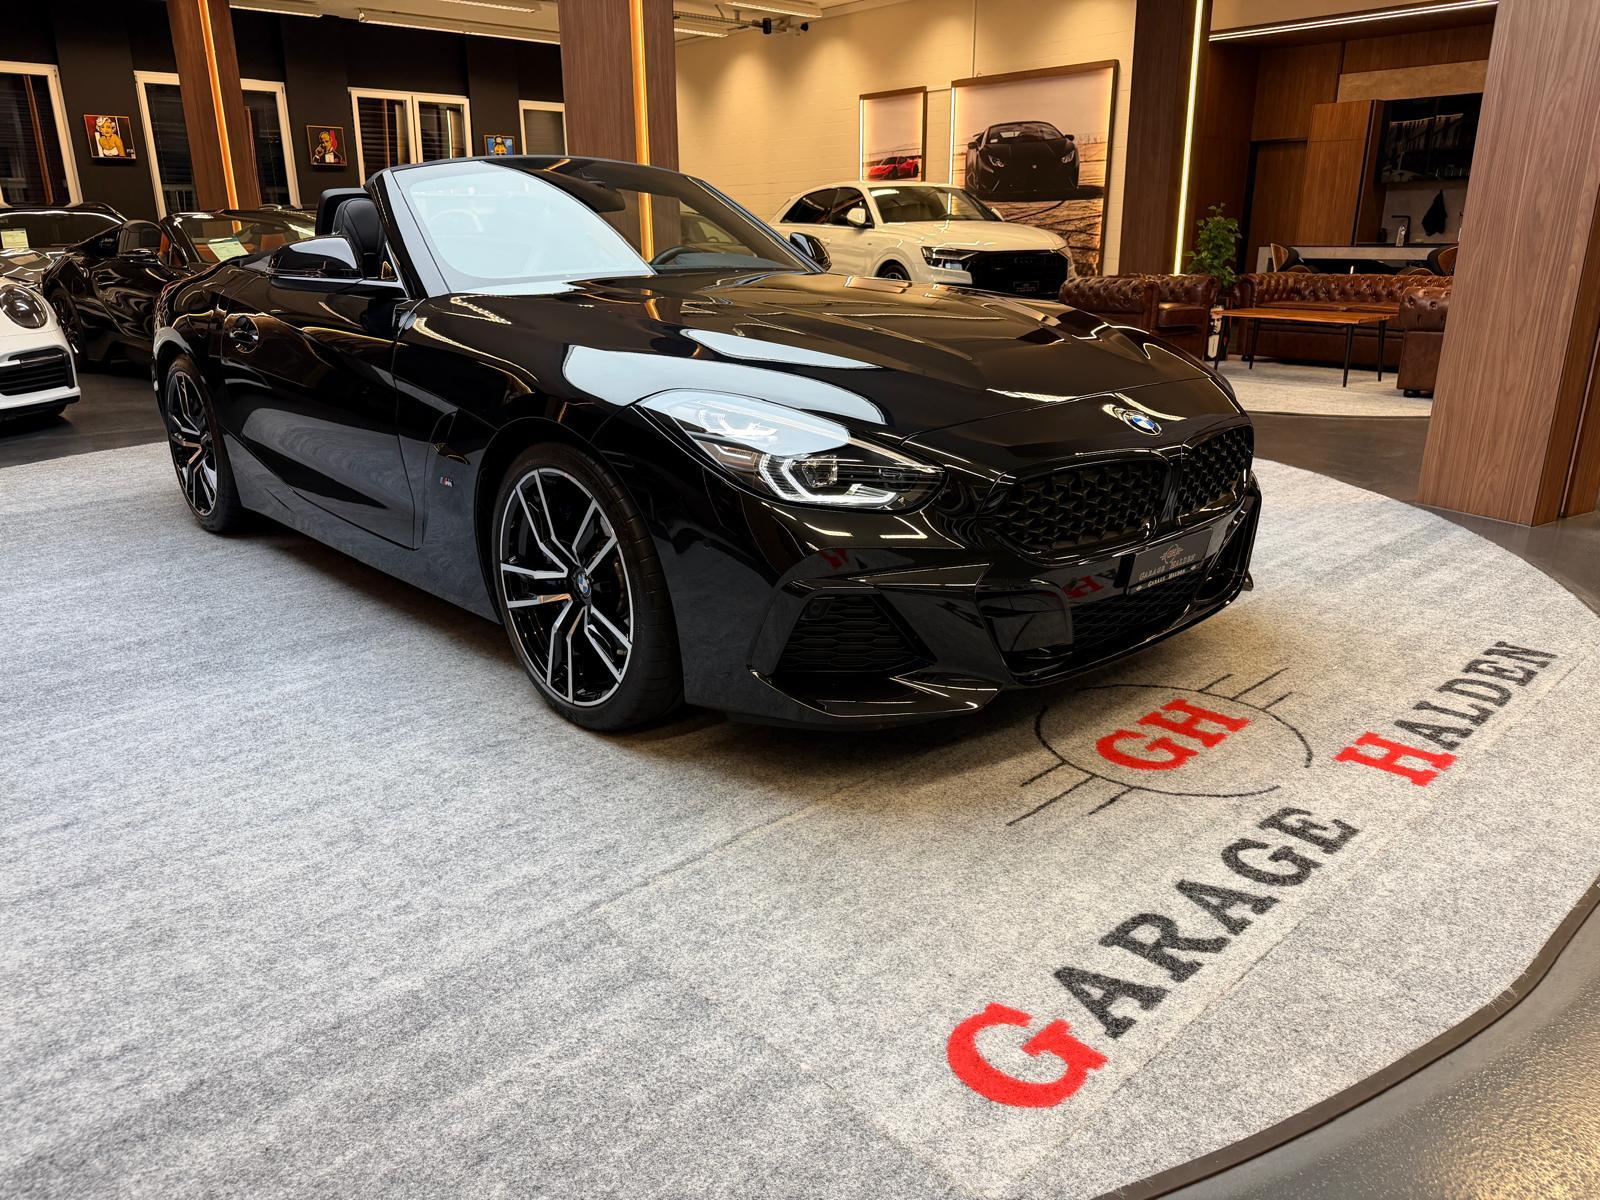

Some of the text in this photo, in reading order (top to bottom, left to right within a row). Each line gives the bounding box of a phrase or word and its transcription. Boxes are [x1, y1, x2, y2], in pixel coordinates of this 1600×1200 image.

[1096, 699, 1251, 771] GH
[946, 641, 1559, 1108] GARAGE HALDEN
